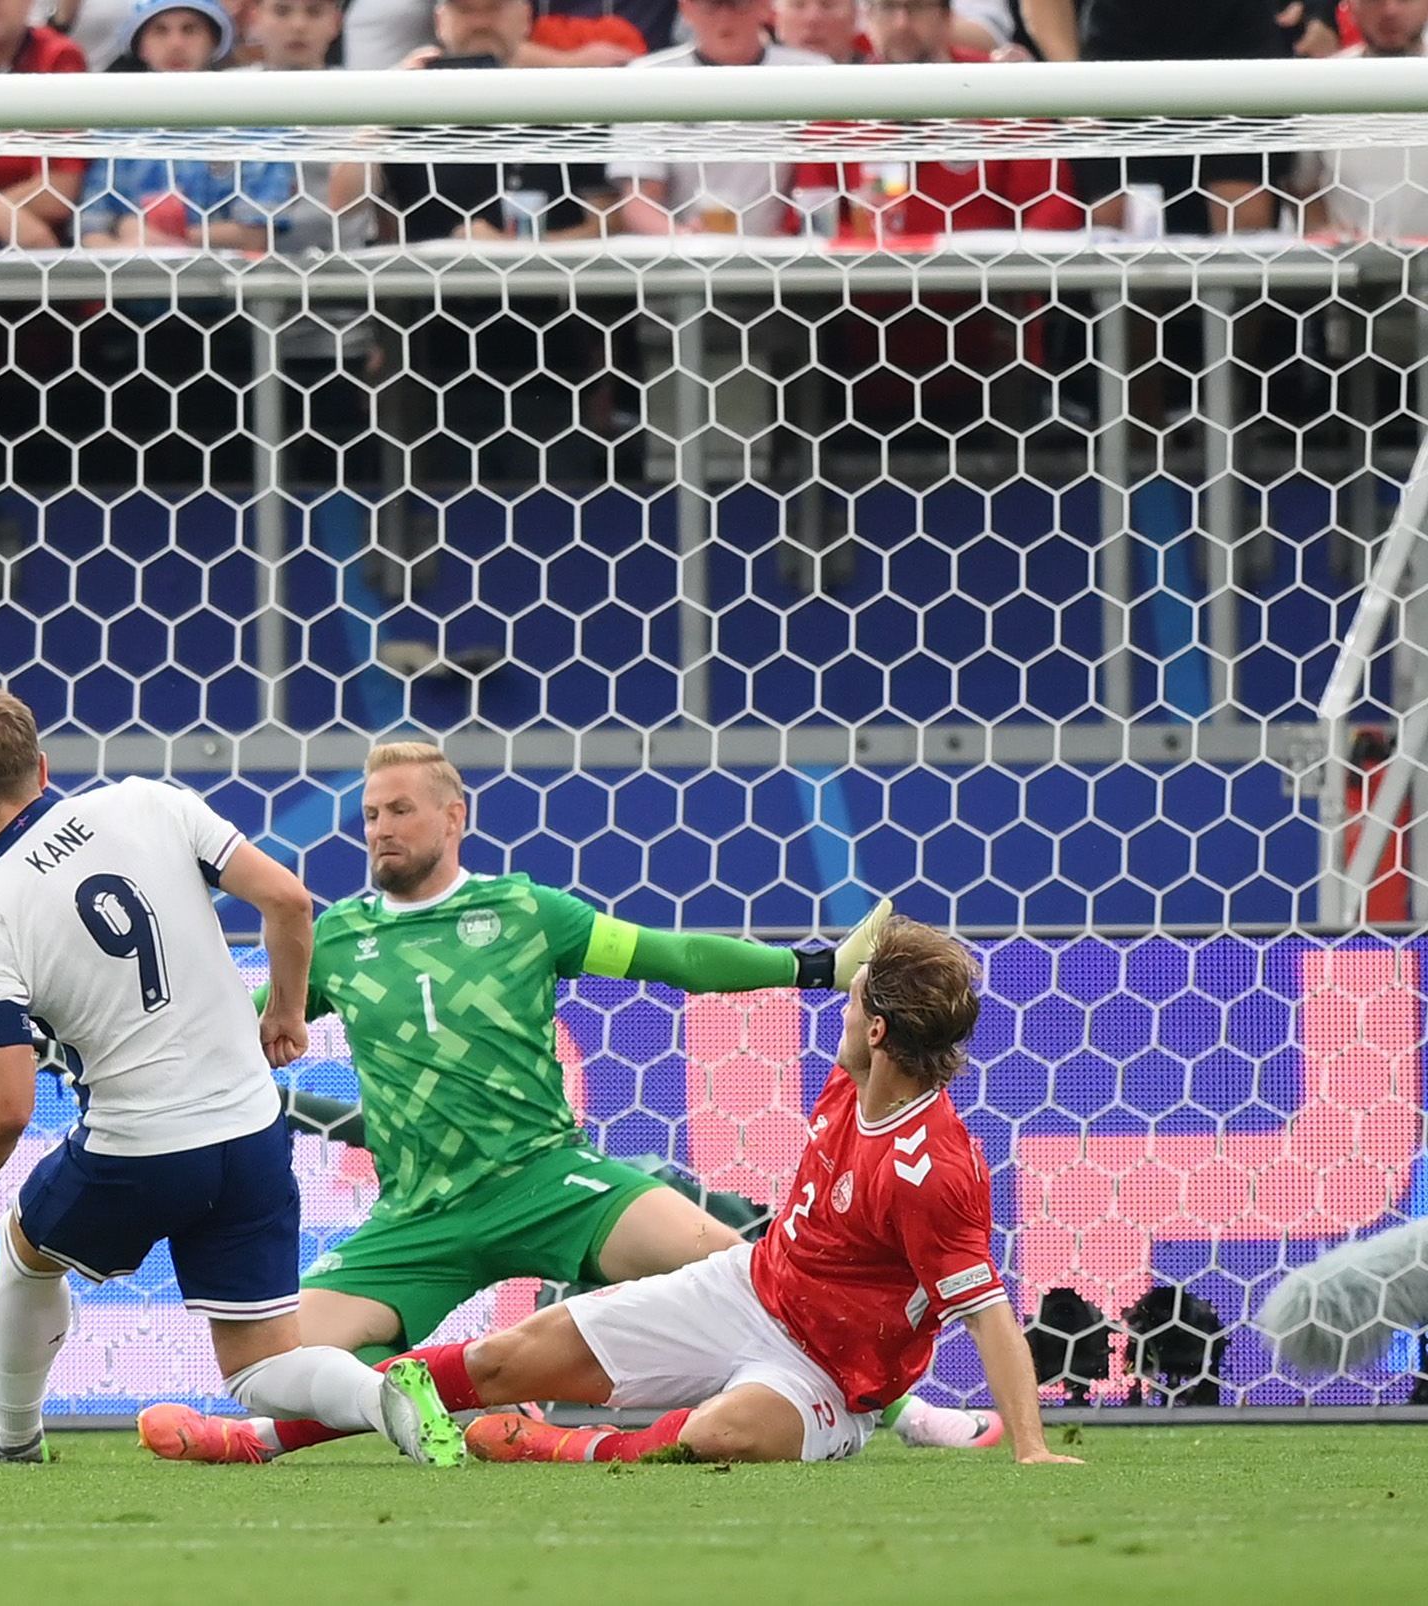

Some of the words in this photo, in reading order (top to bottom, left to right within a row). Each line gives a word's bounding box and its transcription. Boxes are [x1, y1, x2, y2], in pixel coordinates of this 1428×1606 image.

[25, 816, 95, 875] KANE
[75, 873, 172, 1014] 9
[415, 973, 438, 1033] 1
[563, 1173, 611, 1193] 1
[783, 1181, 816, 1241] 2
[811, 1399, 836, 1431] 2
